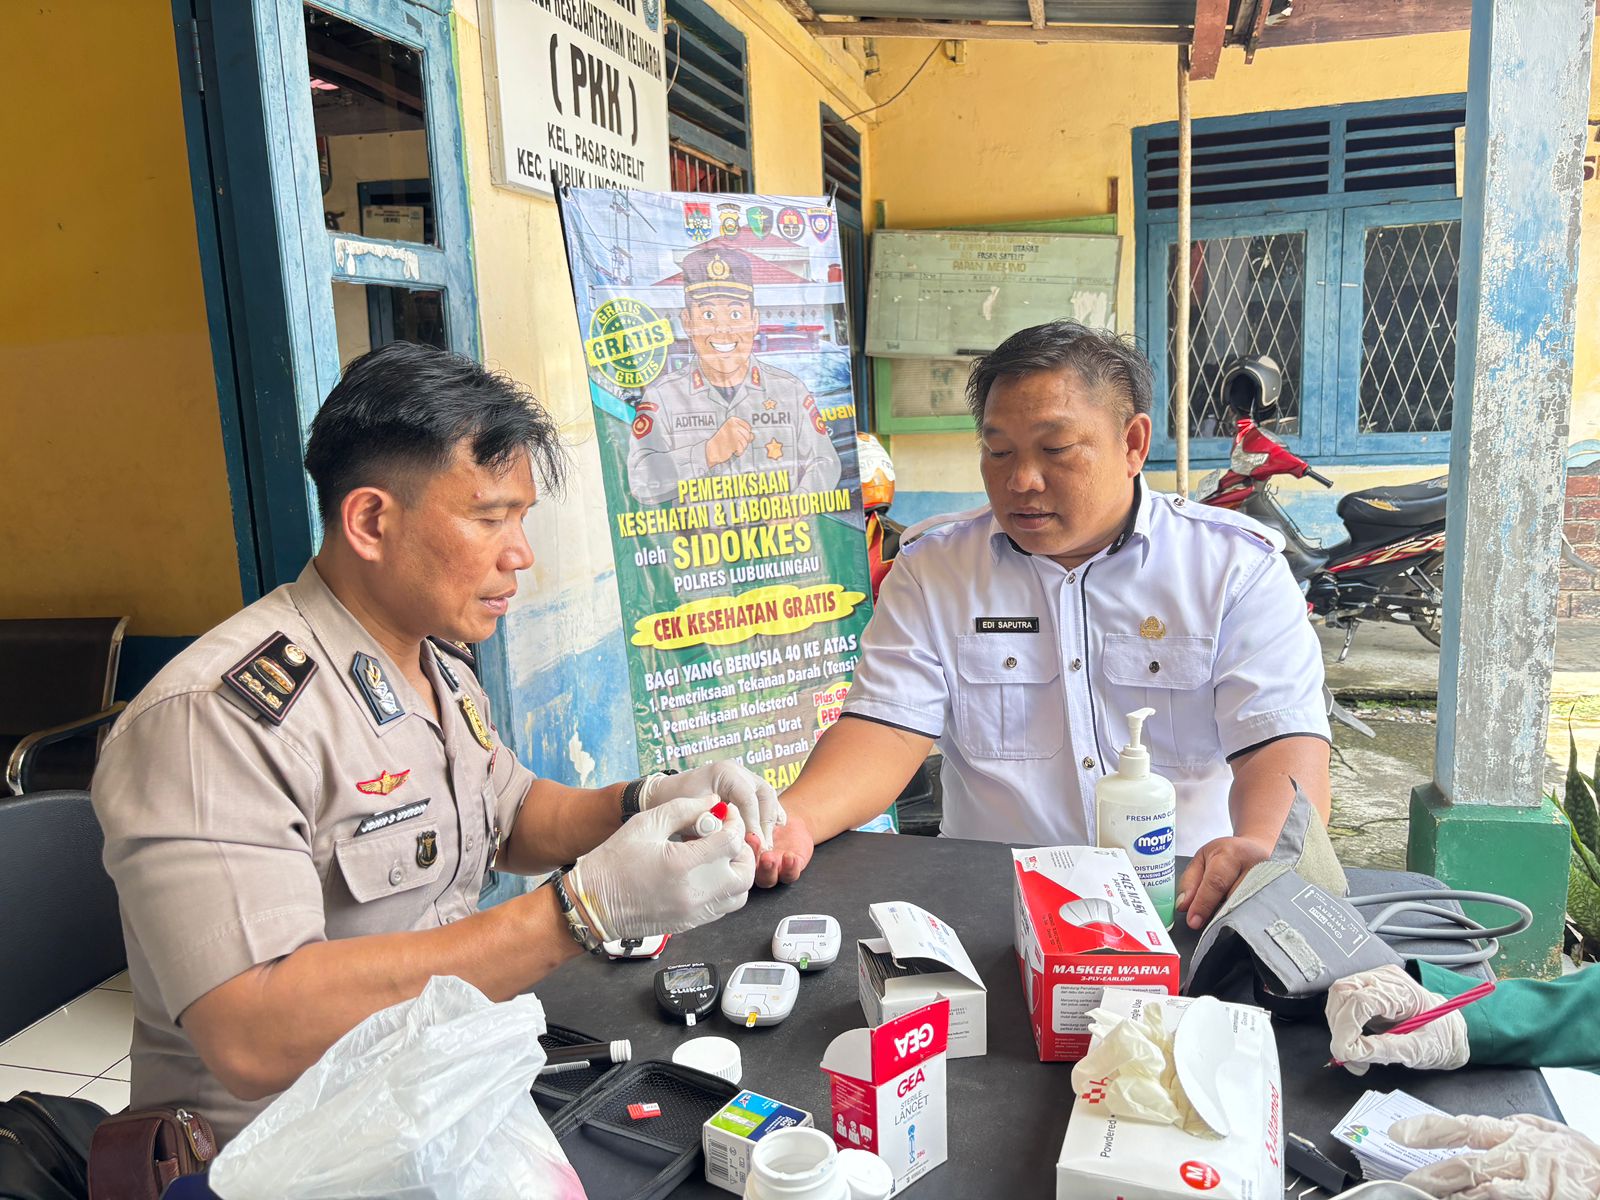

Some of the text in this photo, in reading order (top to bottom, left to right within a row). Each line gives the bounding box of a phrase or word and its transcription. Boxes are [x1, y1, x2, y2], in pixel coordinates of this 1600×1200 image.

[626, 28, 662, 82] KELUARGA
[517, 148, 546, 181] KEC.
[547, 122, 645, 182] KEL. PASAR SATELIT
[597, 298, 642, 324] GRATIS
[592, 324, 667, 361] GRATIS
[614, 360, 660, 384] GRATIS
[676, 413, 791, 428] ADITHIA POLRI
[678, 470, 790, 503] PEMERIKSAAN
[617, 488, 852, 539] KESEHATAN & LABORATORIUM
[634, 521, 812, 570] oleh SIDOKKES
[673, 556, 821, 593] POLRES LUBUKLINGAU
[653, 591, 837, 641] CEK KESEHATAN GRATIS
[982, 620, 1033, 629] EDI SAPUTRA
[644, 634, 859, 691] BAGI YANG BERUSIA 40 KE ATAS
[649, 655, 859, 713] 1. Pemeriksaan Tekanan Darah (Tensi)
[814, 692, 834, 706] Plus
[662, 706, 739, 734] Pemeriksaan
[740, 692, 799, 716] Kolesterol
[656, 716, 803, 764] 3. Pemeriksaan Asam Urat
[746, 747, 773, 764] Gula
[774, 738, 810, 758] Darah
[1152, 812, 1166, 821] AND
[1151, 845, 1166, 853] CARE
[1134, 861, 1172, 872] OISTURIZING
[1316, 904, 1346, 932] ARTERY
[1052, 963, 1171, 975] MASKER WARNA
[895, 1023, 934, 1058] GEA
[897, 1068, 925, 1098] GEA
[895, 1094, 929, 1125] LANCET
[1100, 1119, 1117, 1159] Powdered
[1186, 1165, 1204, 1181] M
